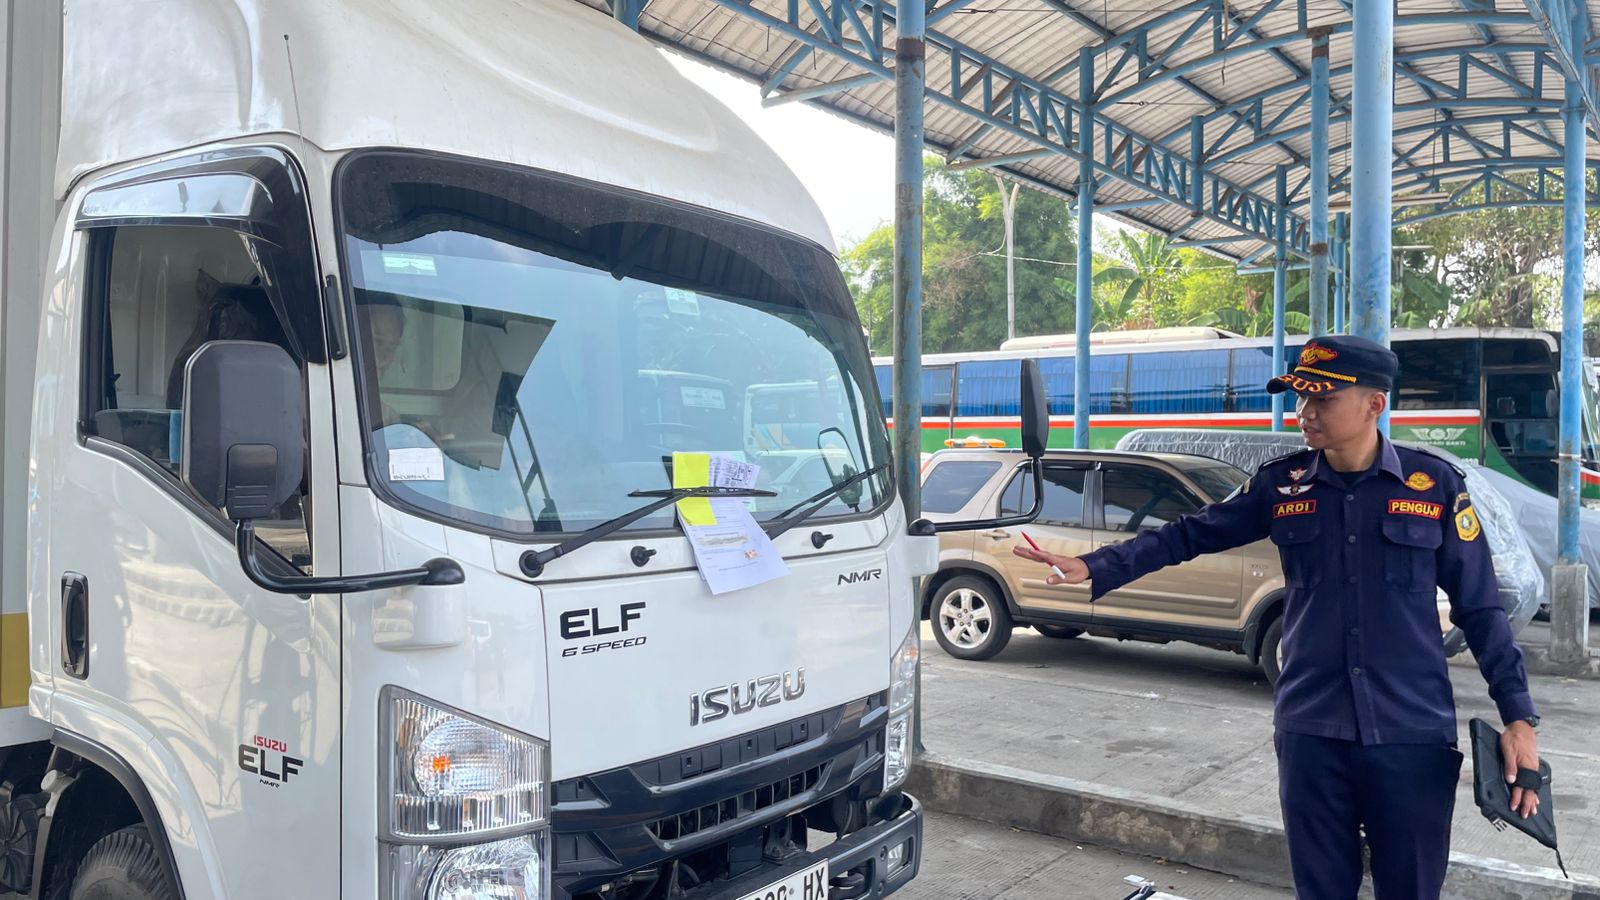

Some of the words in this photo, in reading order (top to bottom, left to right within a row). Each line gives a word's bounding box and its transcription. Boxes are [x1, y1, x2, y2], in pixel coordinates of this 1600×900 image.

[1277, 502, 1309, 516] ARDI
[1391, 501, 1440, 517] PENGUJI
[837, 569, 882, 586] NMR
[560, 601, 646, 640] ELF
[581, 636, 647, 655] SPEED
[689, 666, 806, 727] ISUZU
[253, 734, 288, 753] ISUZU
[239, 743, 304, 783] ELF
[259, 778, 280, 788] NMR
